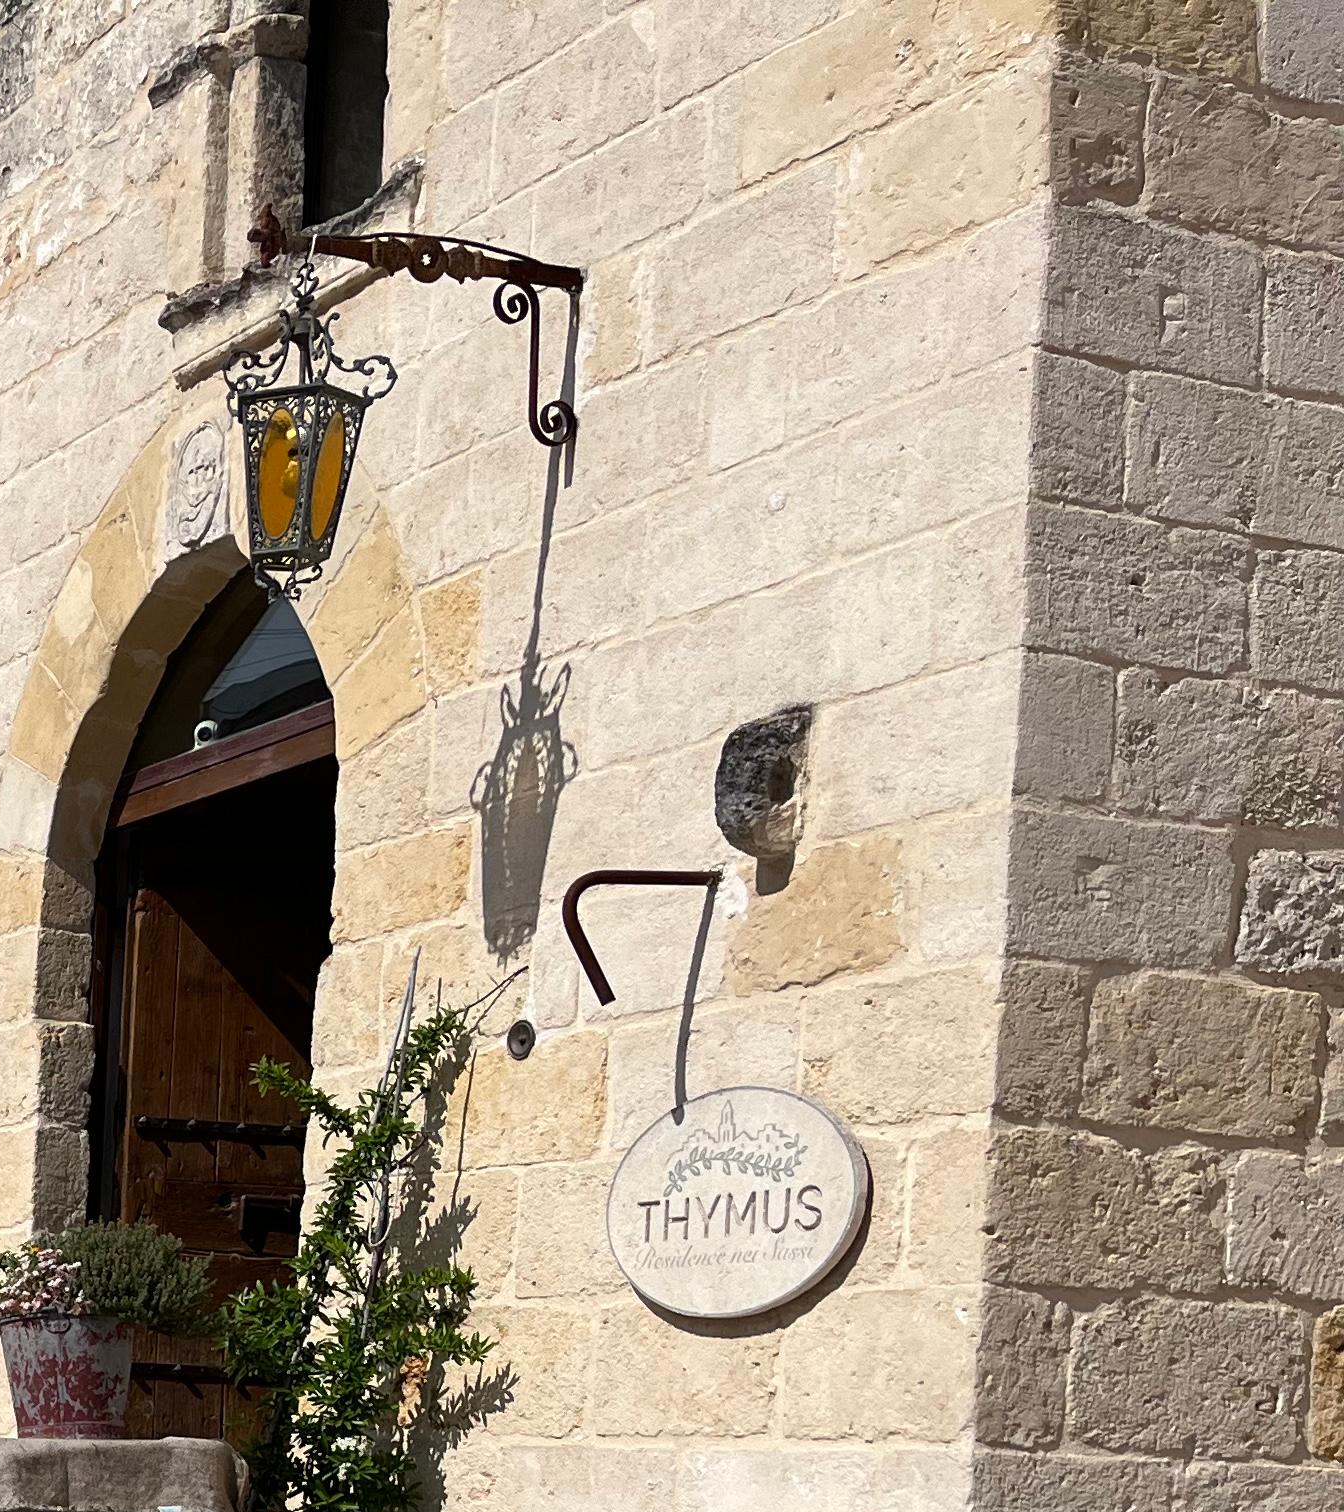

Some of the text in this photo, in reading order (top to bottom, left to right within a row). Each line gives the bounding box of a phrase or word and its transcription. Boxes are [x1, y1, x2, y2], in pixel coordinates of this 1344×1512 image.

[637, 1184, 823, 1243] THYMUS
[633, 1245, 726, 1269] Residence
[763, 1237, 814, 1261] Sassi
